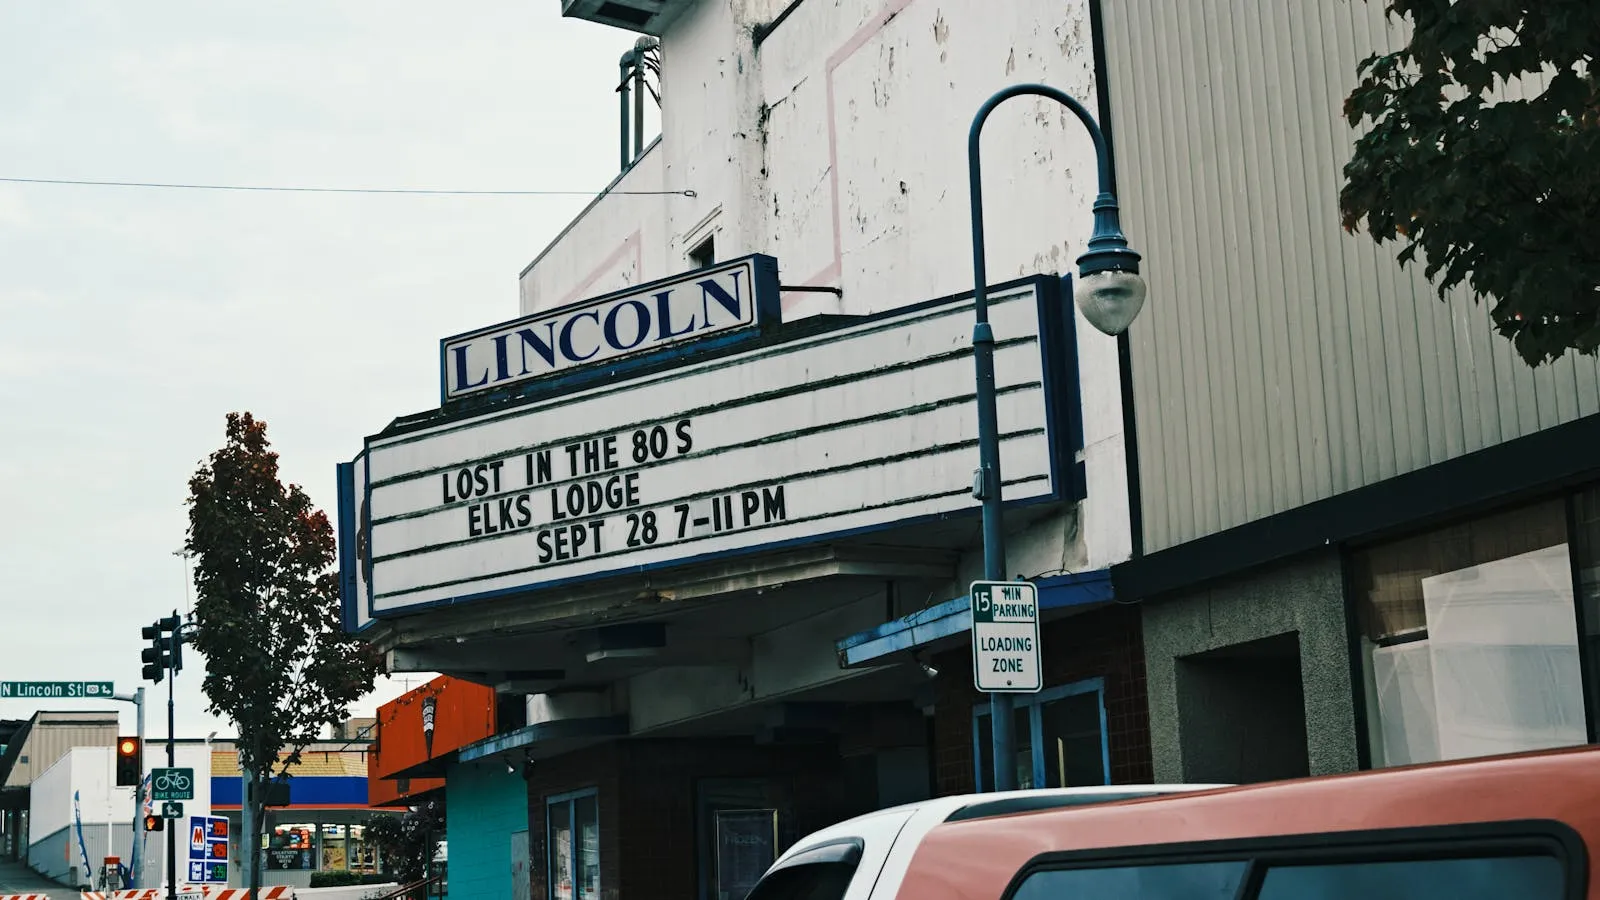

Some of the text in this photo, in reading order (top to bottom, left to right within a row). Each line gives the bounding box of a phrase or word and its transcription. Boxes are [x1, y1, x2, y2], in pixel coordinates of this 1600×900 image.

[451, 270, 744, 392] LINCOLN
[443, 461, 503, 504] LOST
[526, 450, 552, 485] IN
[565, 436, 618, 476] THE
[469, 473, 640, 537] ELKS LODGE
[536, 520, 605, 563] SEPT
[626, 510, 658, 547] 28
[742, 485, 786, 526] PM
[1004, 588, 1021, 600] MIN
[975, 592, 990, 612] 15
[993, 604, 1034, 617] PARKING
[981, 637, 1032, 651] LOADING
[993, 658, 1023, 672] ZONE
[2, 683, 11, 696] N
[17, 683, 62, 696] Lincoln
[67, 683, 82, 696] St
[155, 791, 190, 799] BIKE ROUTE
